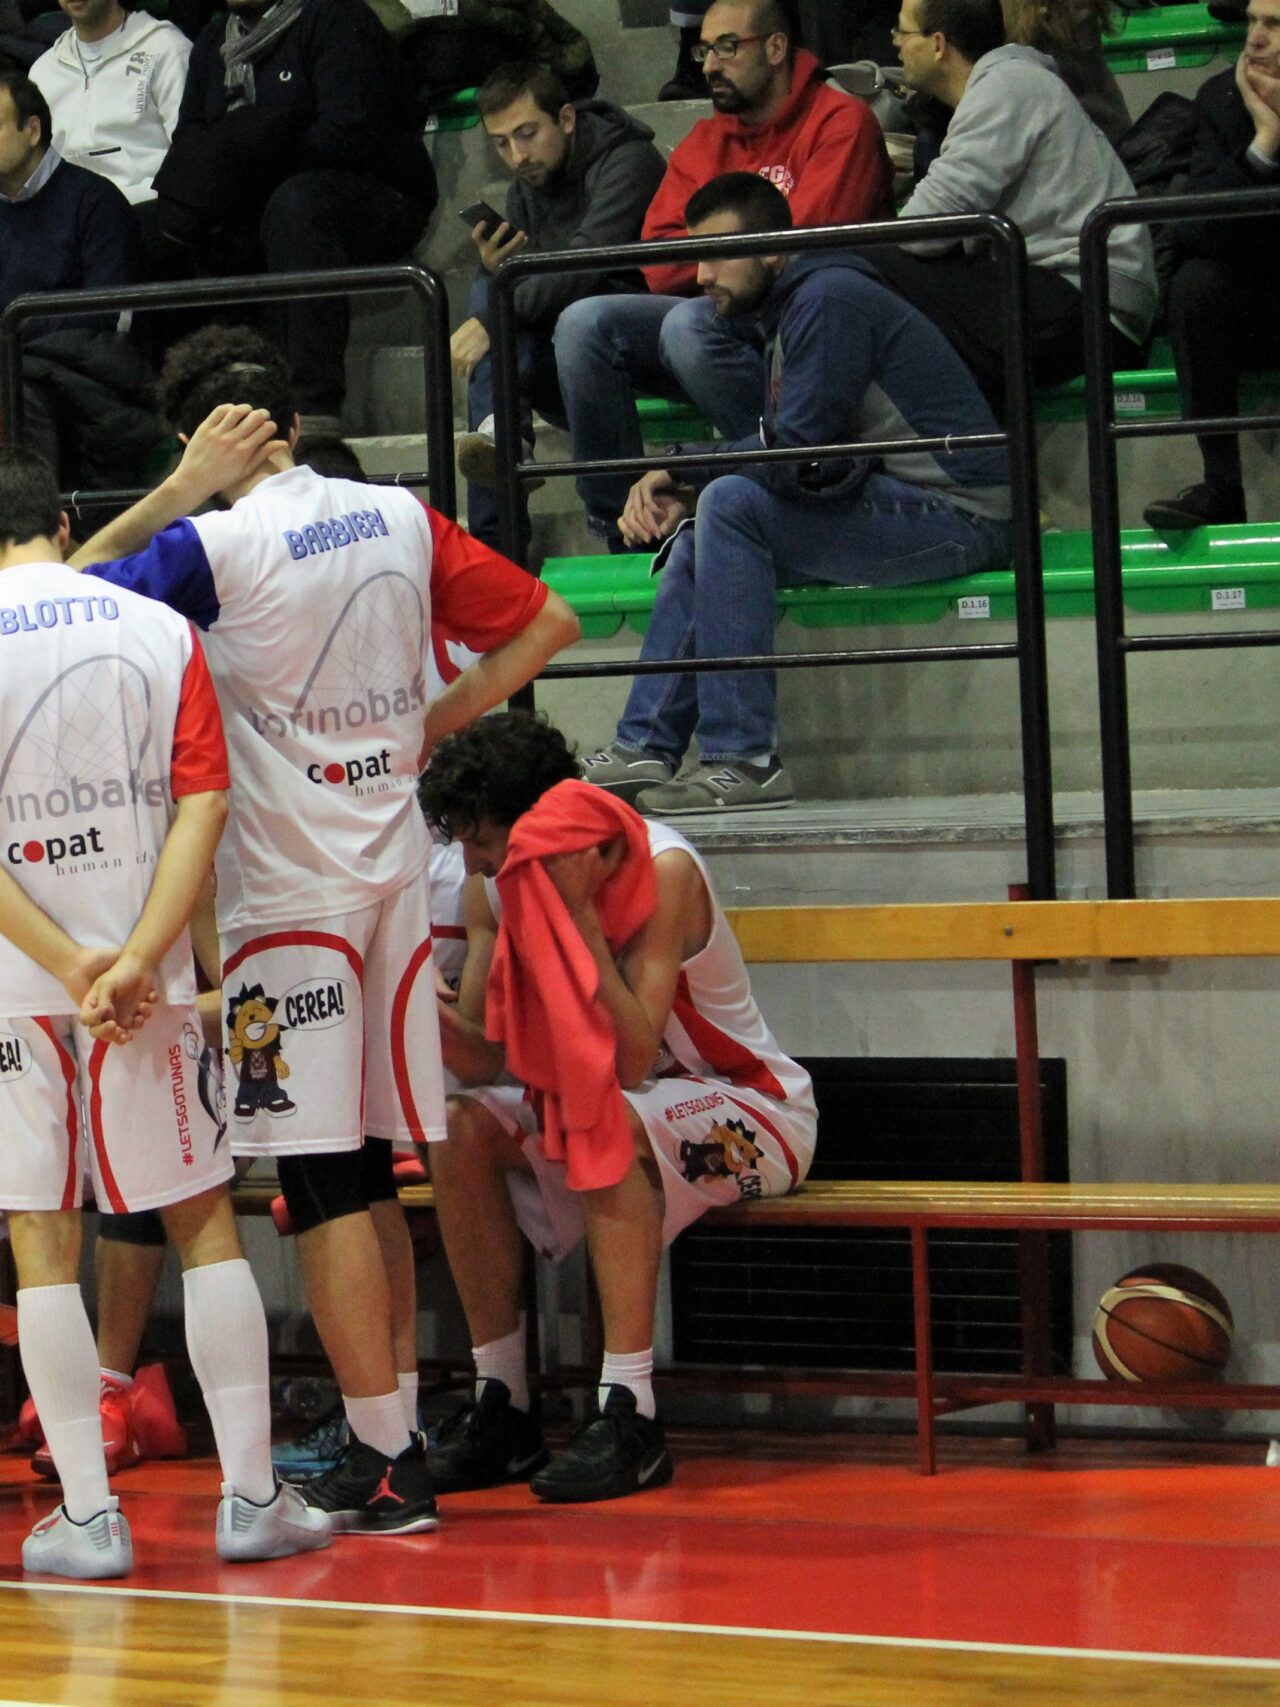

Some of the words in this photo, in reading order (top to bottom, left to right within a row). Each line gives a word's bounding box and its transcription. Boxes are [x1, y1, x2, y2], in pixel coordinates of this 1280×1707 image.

[282, 508, 390, 560] BARBIERI
[307, 749, 391, 786] copat
[8, 827, 104, 865] copat
[56, 856, 123, 877] human
[285, 982, 345, 1027] CEREA!
[168, 1044, 194, 1166] #LETSGOTUNAS
